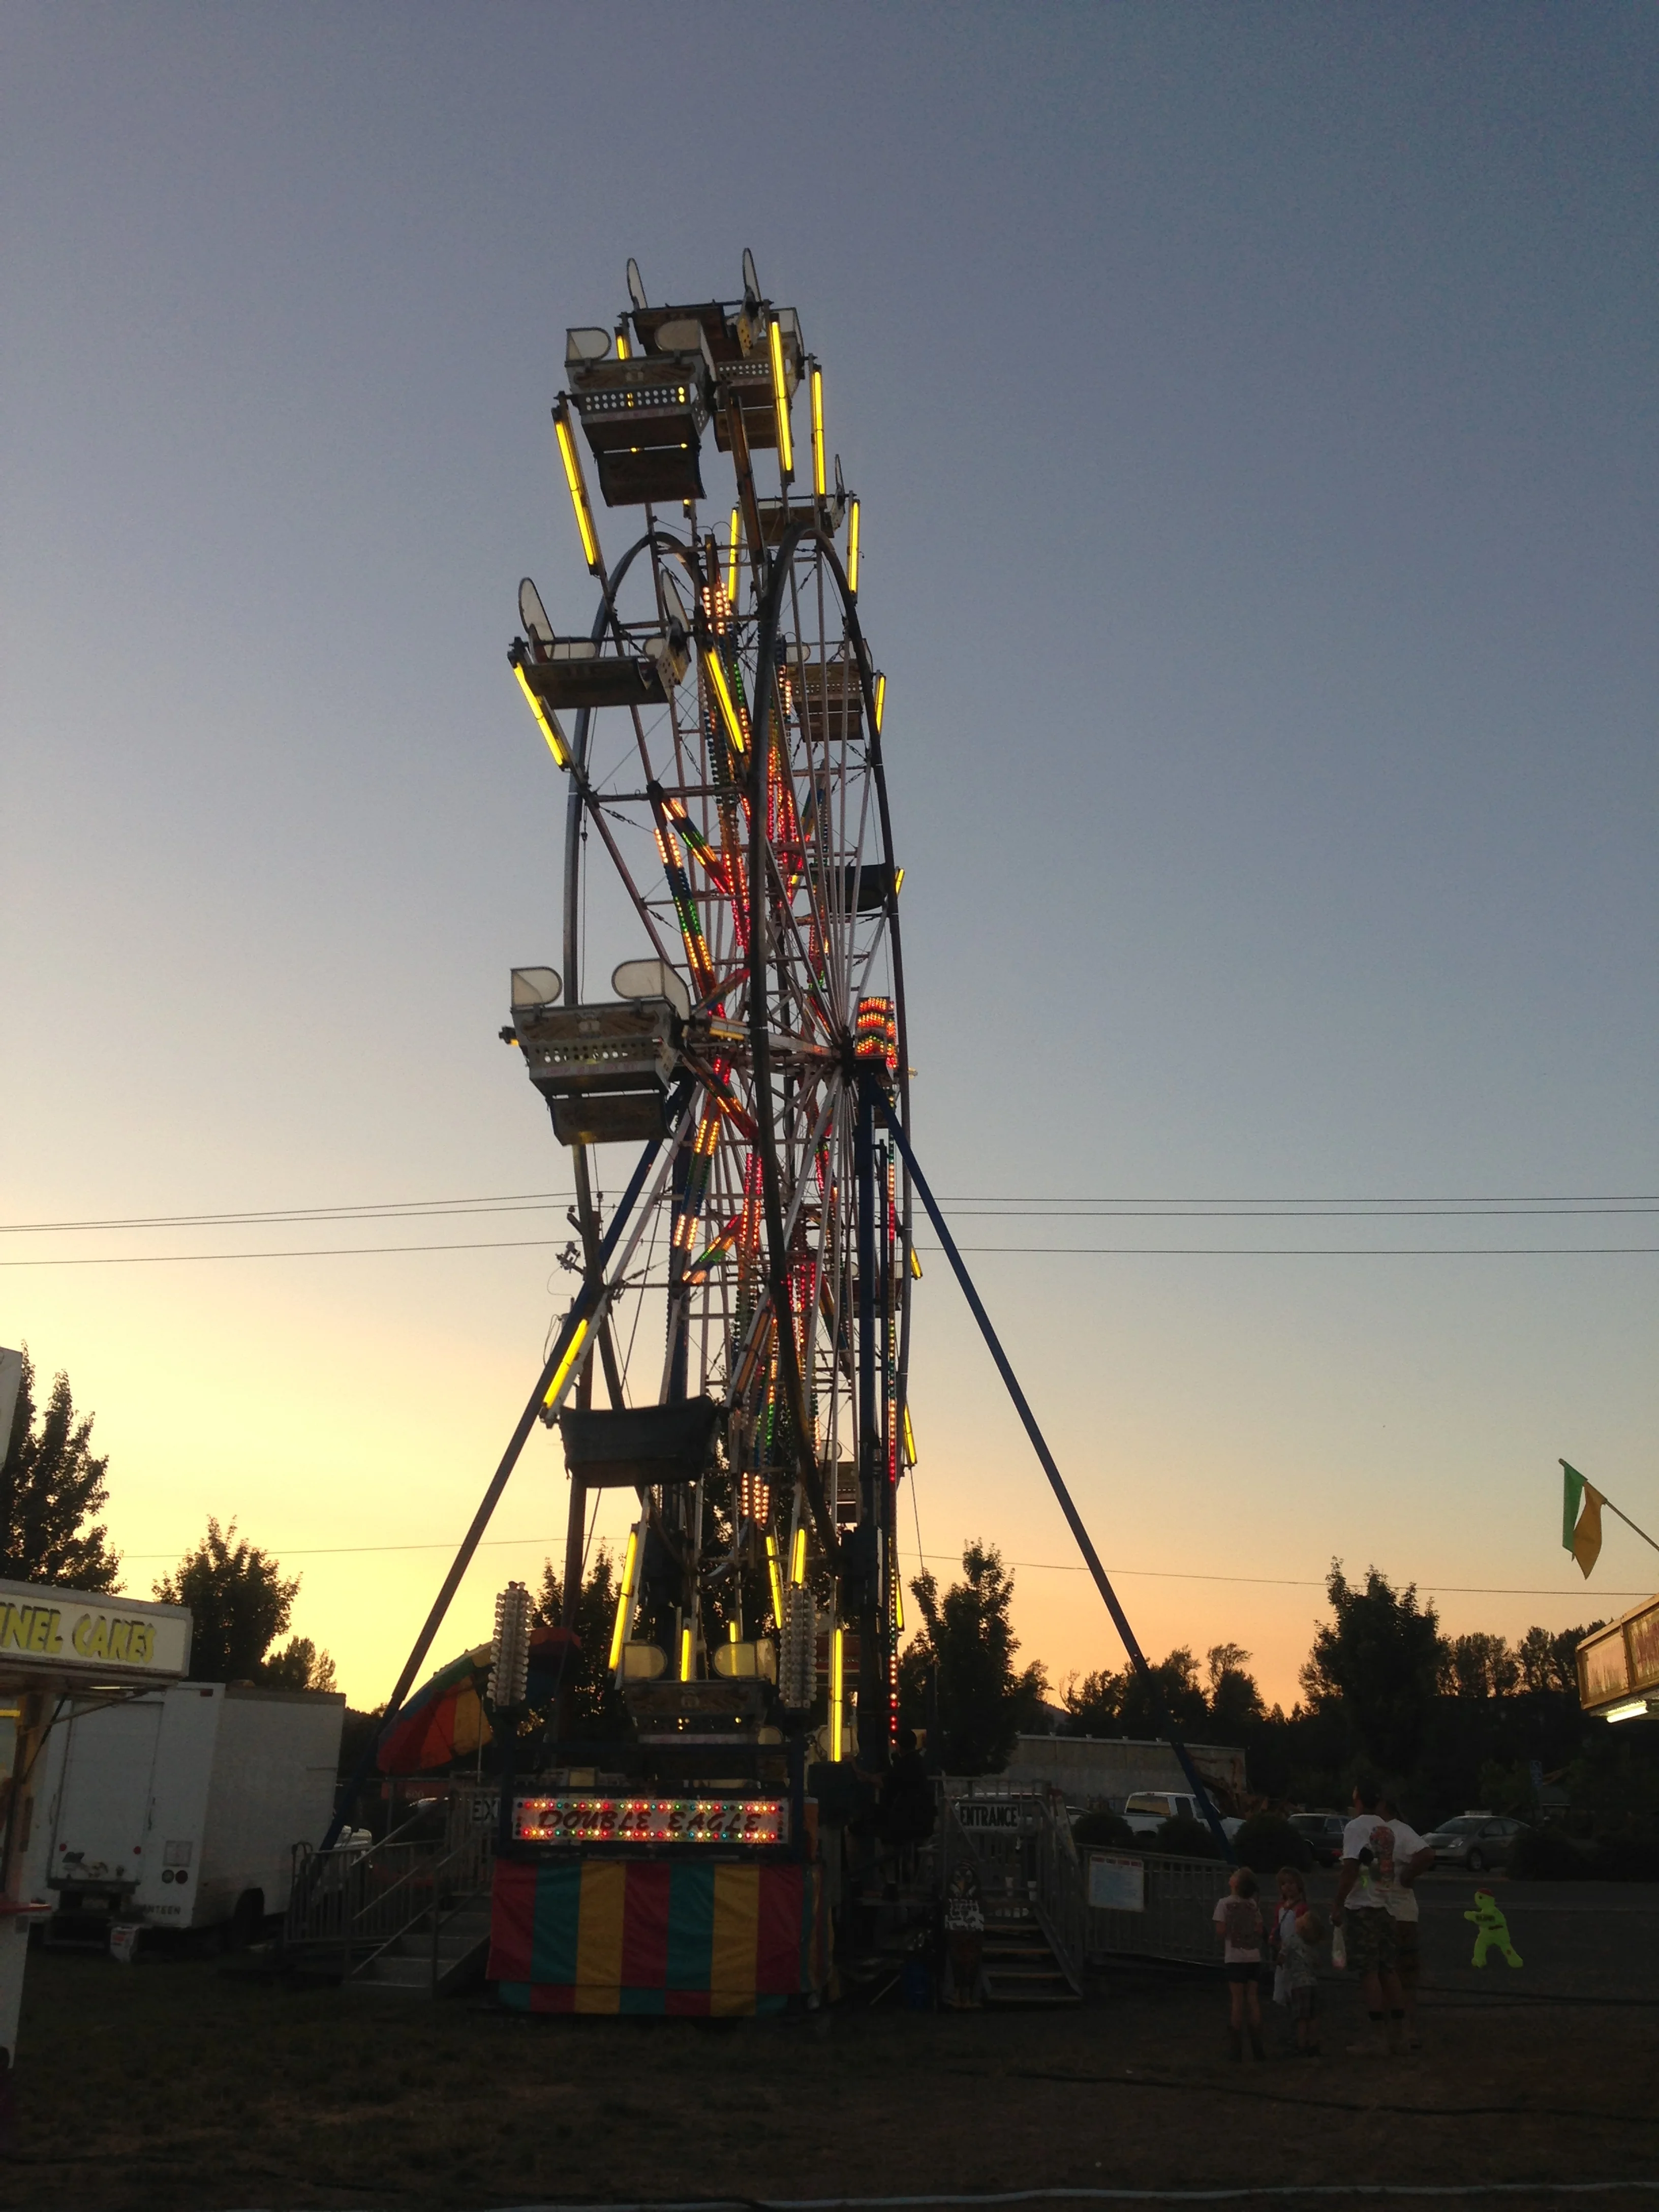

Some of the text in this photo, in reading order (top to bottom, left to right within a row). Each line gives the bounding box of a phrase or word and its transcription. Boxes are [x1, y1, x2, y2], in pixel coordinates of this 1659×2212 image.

[0, 1602, 156, 1664] NEL CAKES
[473, 1800, 497, 1821] EX
[539, 1810, 762, 1832] DOUBLE EAGLE
[960, 1806, 1018, 1826] ENTRANCE
